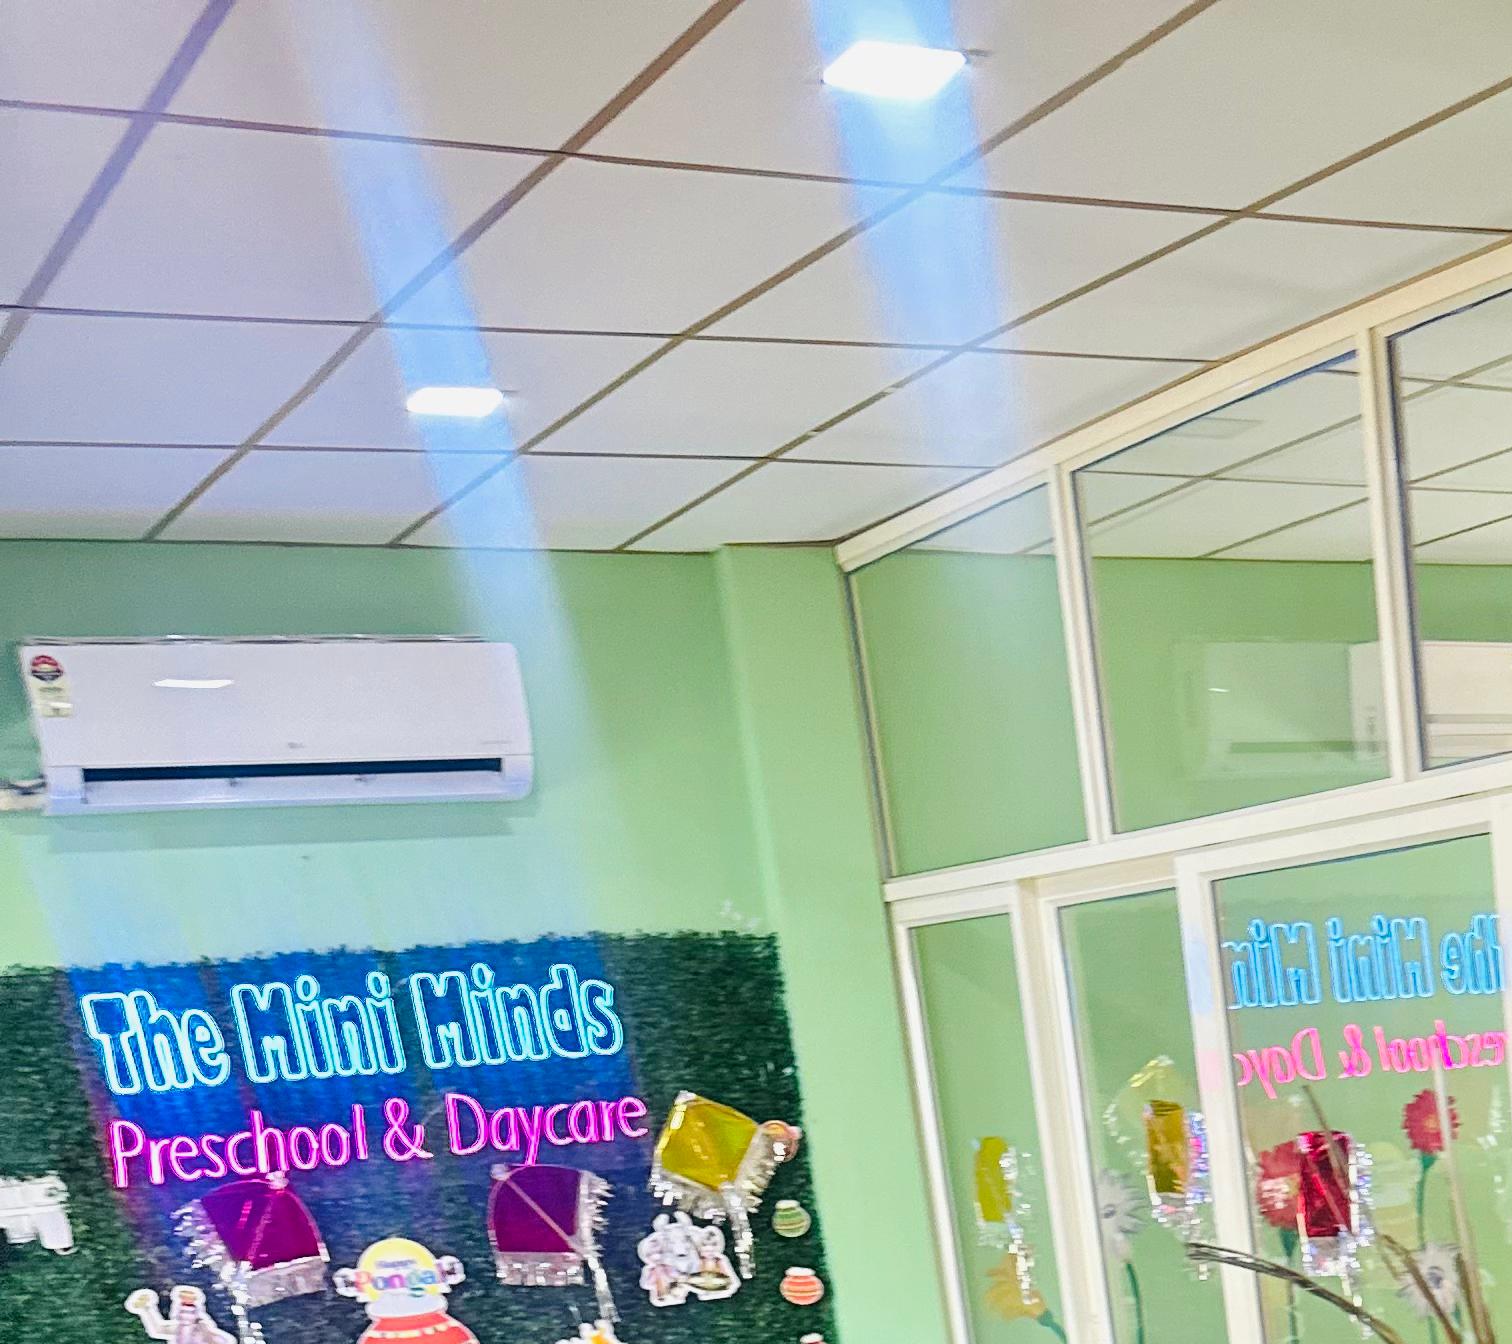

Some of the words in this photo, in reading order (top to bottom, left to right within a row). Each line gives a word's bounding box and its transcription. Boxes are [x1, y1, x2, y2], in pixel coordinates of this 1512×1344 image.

[80, 988, 231, 1096] The
[230, 971, 407, 1084] Mini
[408, 962, 624, 1070] Minds
[108, 1102, 370, 1189] Preschool
[382, 1096, 434, 1162] &
[445, 1092, 650, 1167] Daycare
